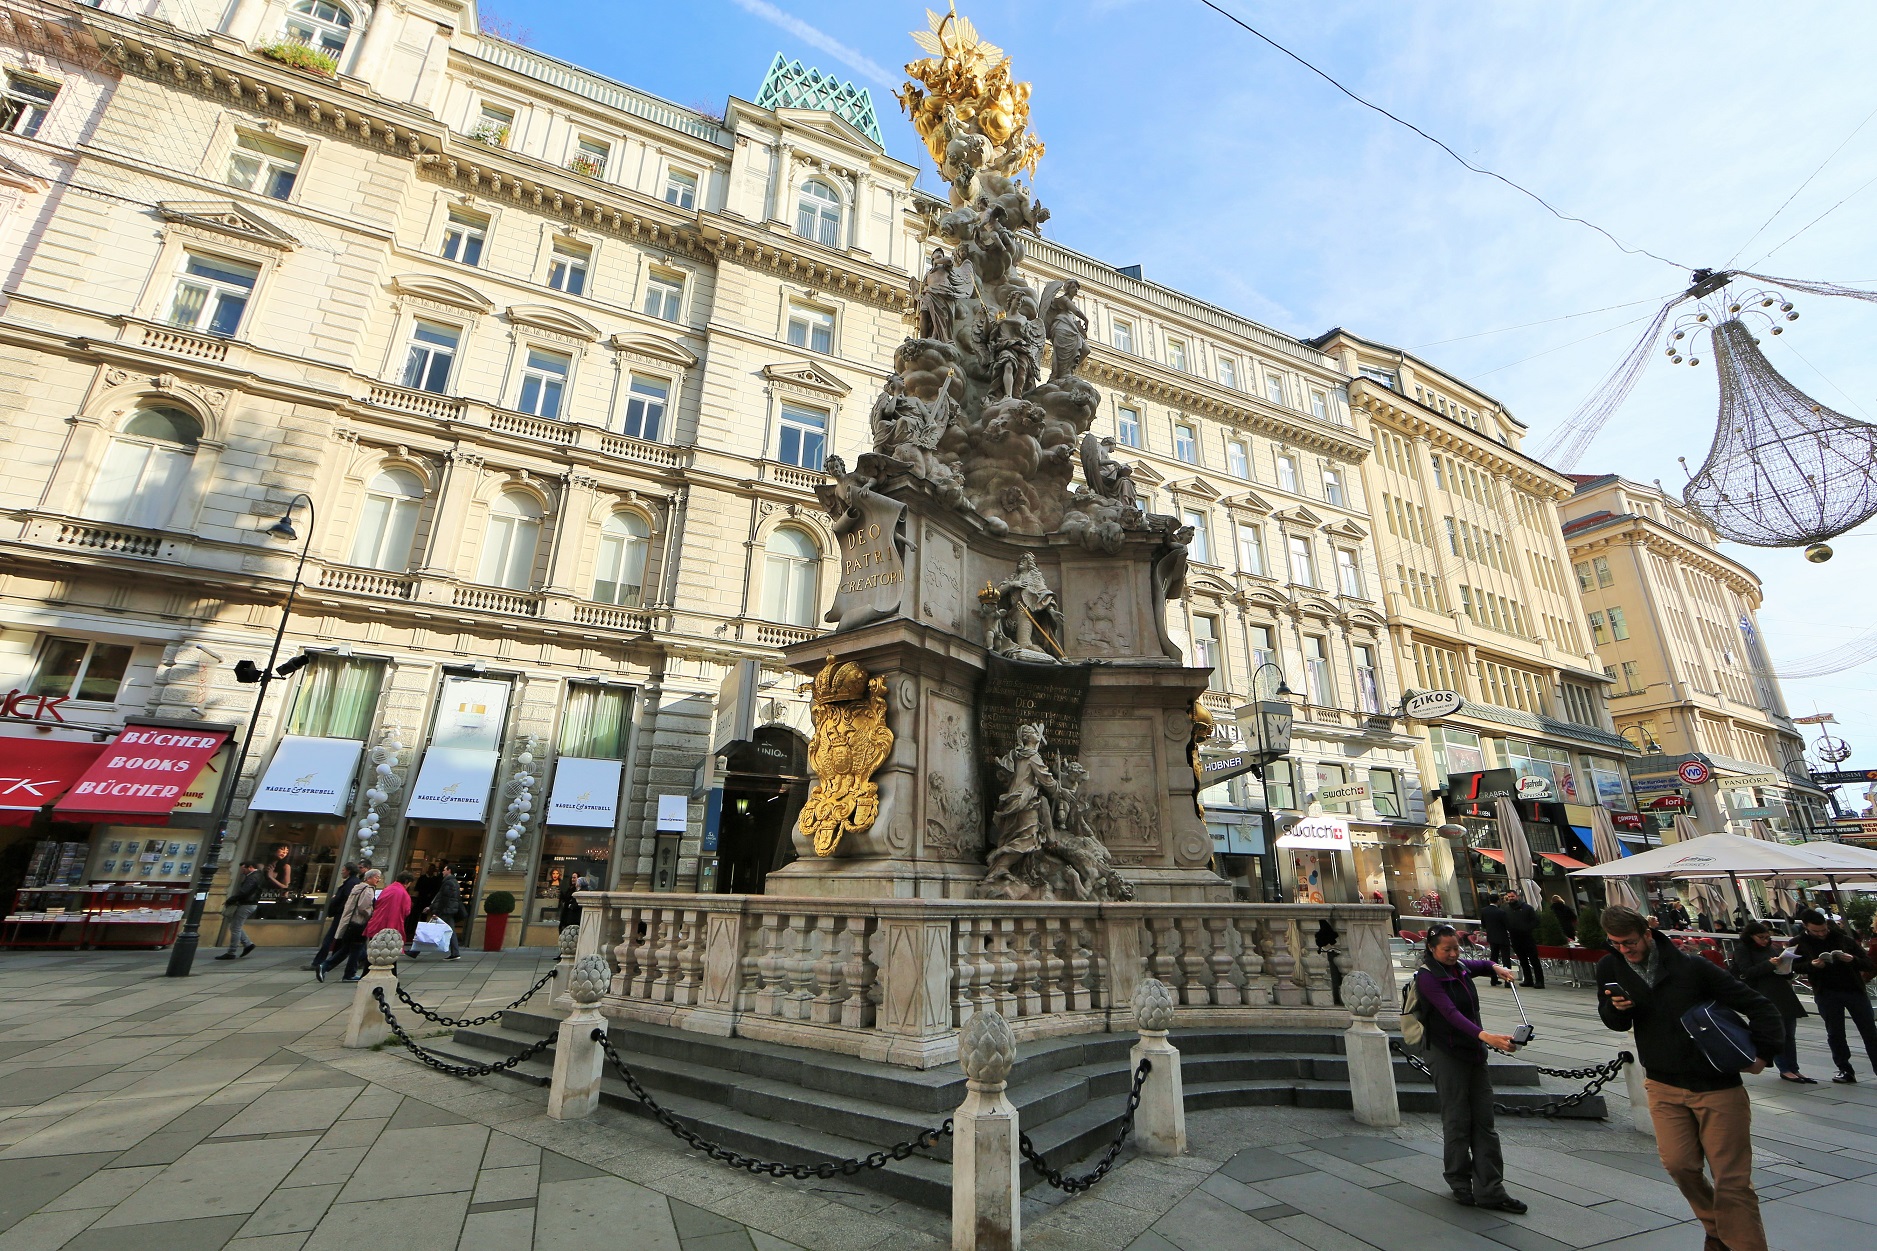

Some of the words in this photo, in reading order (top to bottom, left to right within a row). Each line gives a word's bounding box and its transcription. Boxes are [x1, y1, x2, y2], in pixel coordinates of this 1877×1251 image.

[847, 523, 880, 550] DEO
[845, 546, 893, 575] PATRI
[840, 569, 904, 594] CREATORI
[1411, 693, 1453, 709] ZIKOS
[121, 731, 217, 749] BÜCHER
[107, 756, 190, 772] BOOKS
[1204, 756, 1242, 772] HÜBNER
[1686, 768, 1702, 777] VVD
[74, 779, 180, 798] BÜCHER
[1519, 778, 1544, 790] Segafredo
[1322, 786, 1358, 799] swatch
[1281, 823, 1335, 840] swatch
